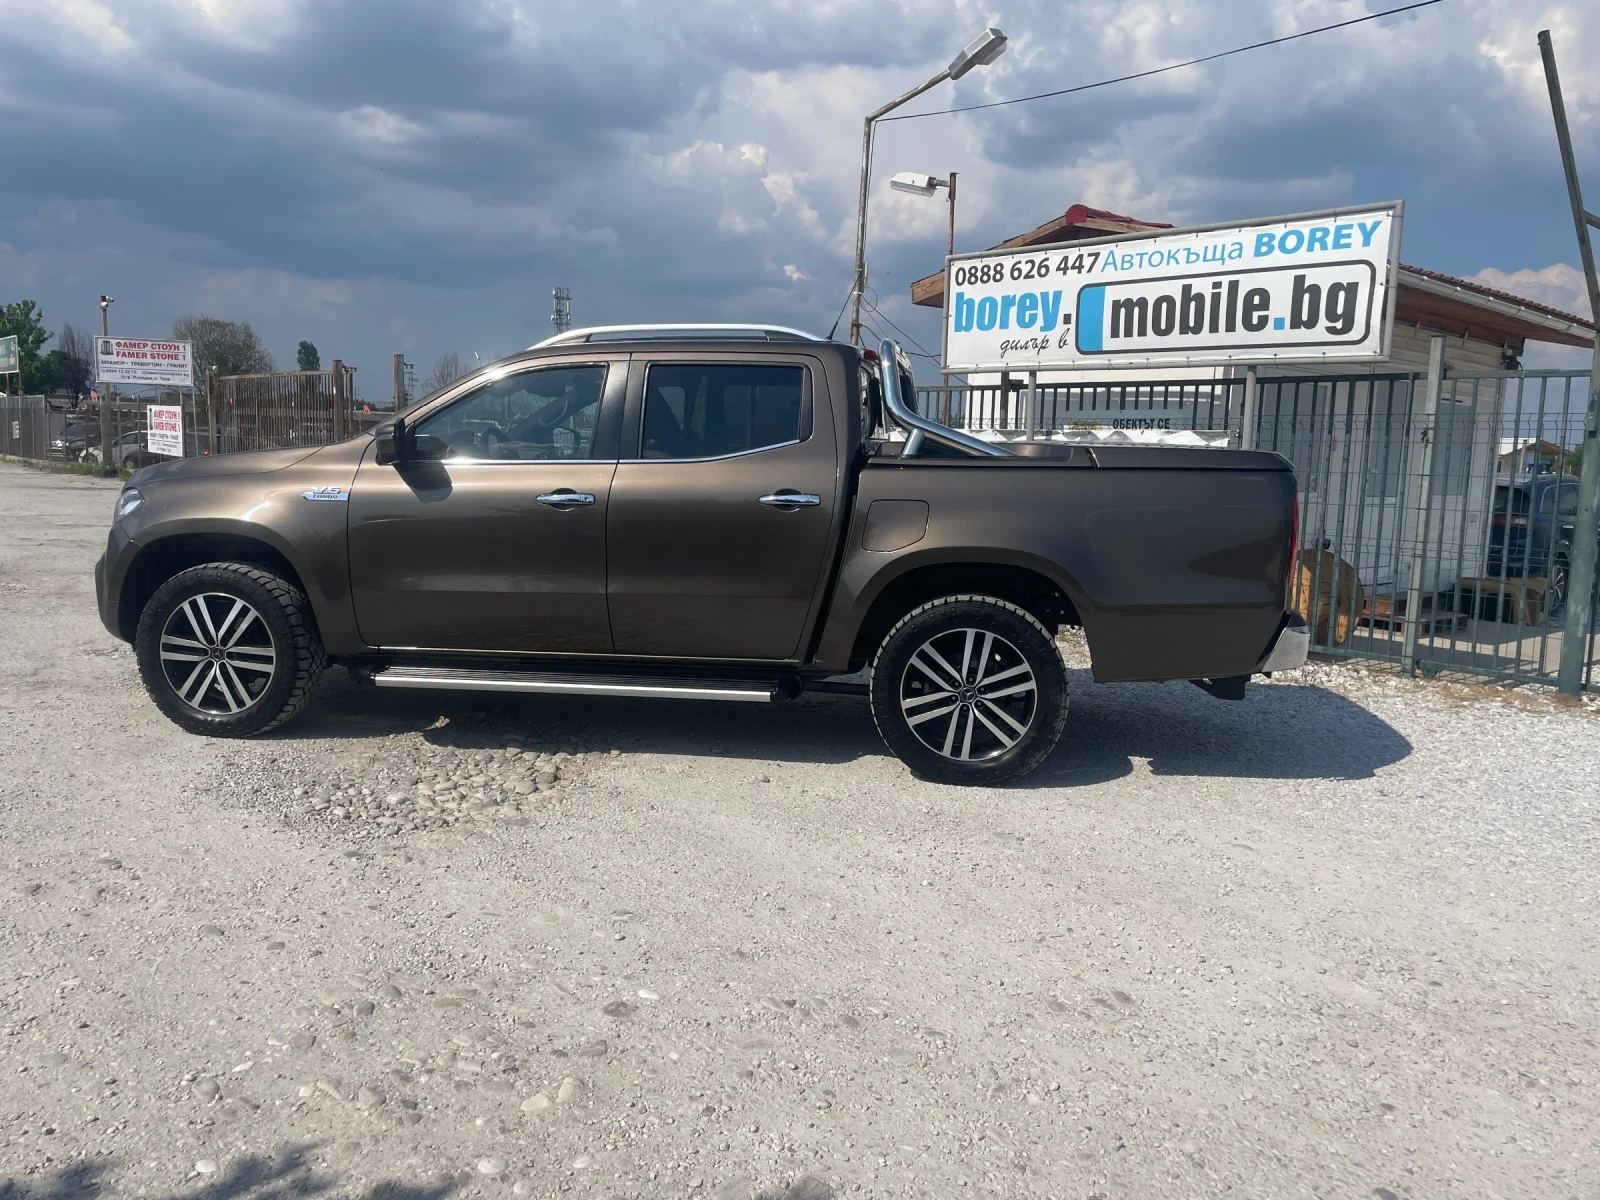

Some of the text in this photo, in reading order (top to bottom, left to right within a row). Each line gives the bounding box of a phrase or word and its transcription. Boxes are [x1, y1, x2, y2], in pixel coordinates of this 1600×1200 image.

[954, 220, 1383, 287] 0888 626 447 Автокъща BOREY
[1110, 273, 1360, 339] mobile.bg
[115, 341, 149, 350] ФАМЕР
[150, 343, 180, 351] СТОУН
[1000, 334, 1050, 359] дилър
[116, 351, 148, 359] FAMER
[150, 352, 180, 360] STONE
[1112, 418, 1154, 430] ОБЕКТЪТ
[1157, 418, 1171, 430] СЕ
